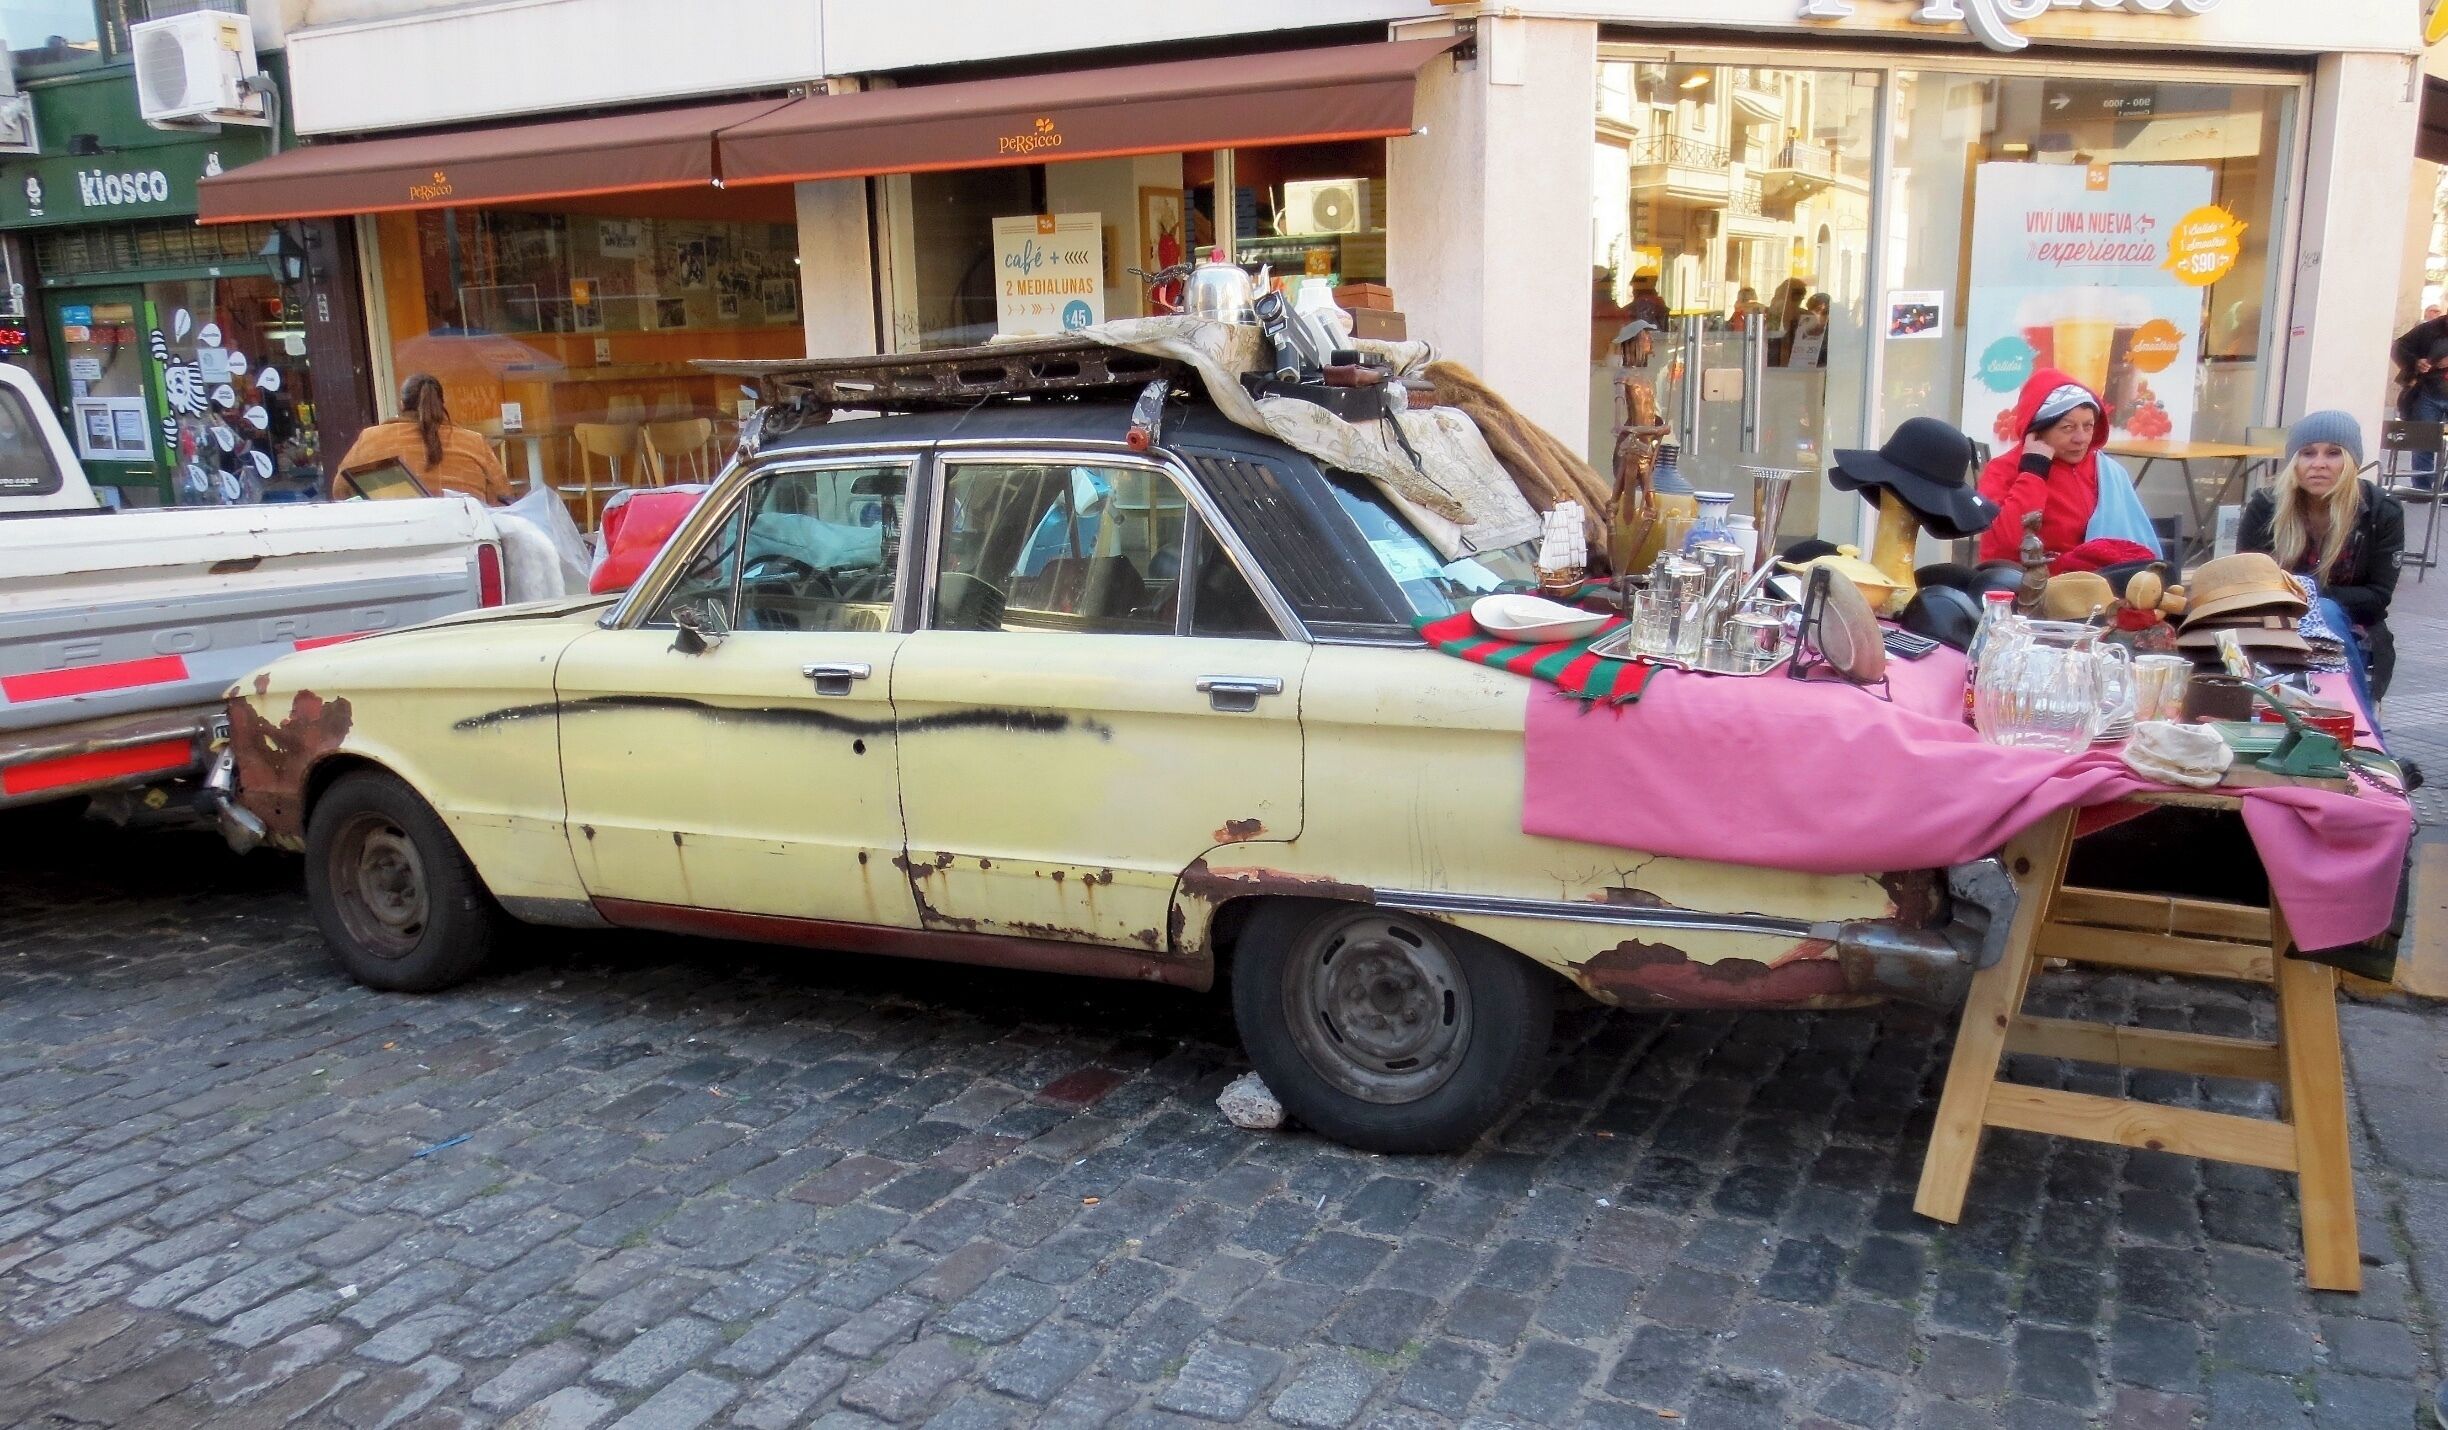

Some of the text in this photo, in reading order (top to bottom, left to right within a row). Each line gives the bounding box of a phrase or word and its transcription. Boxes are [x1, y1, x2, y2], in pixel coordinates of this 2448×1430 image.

[78, 169, 168, 206] kiosco
[2026, 207, 2133, 235] VIVÍ UNA NUEVA
[1004, 239, 1044, 276] café
[2037, 238, 2157, 269] experiencia
[2191, 252, 2216, 275] $90
[1006, 277, 1094, 297] 2 MEDIALUNAS
[42, 606, 400, 669] FORD
